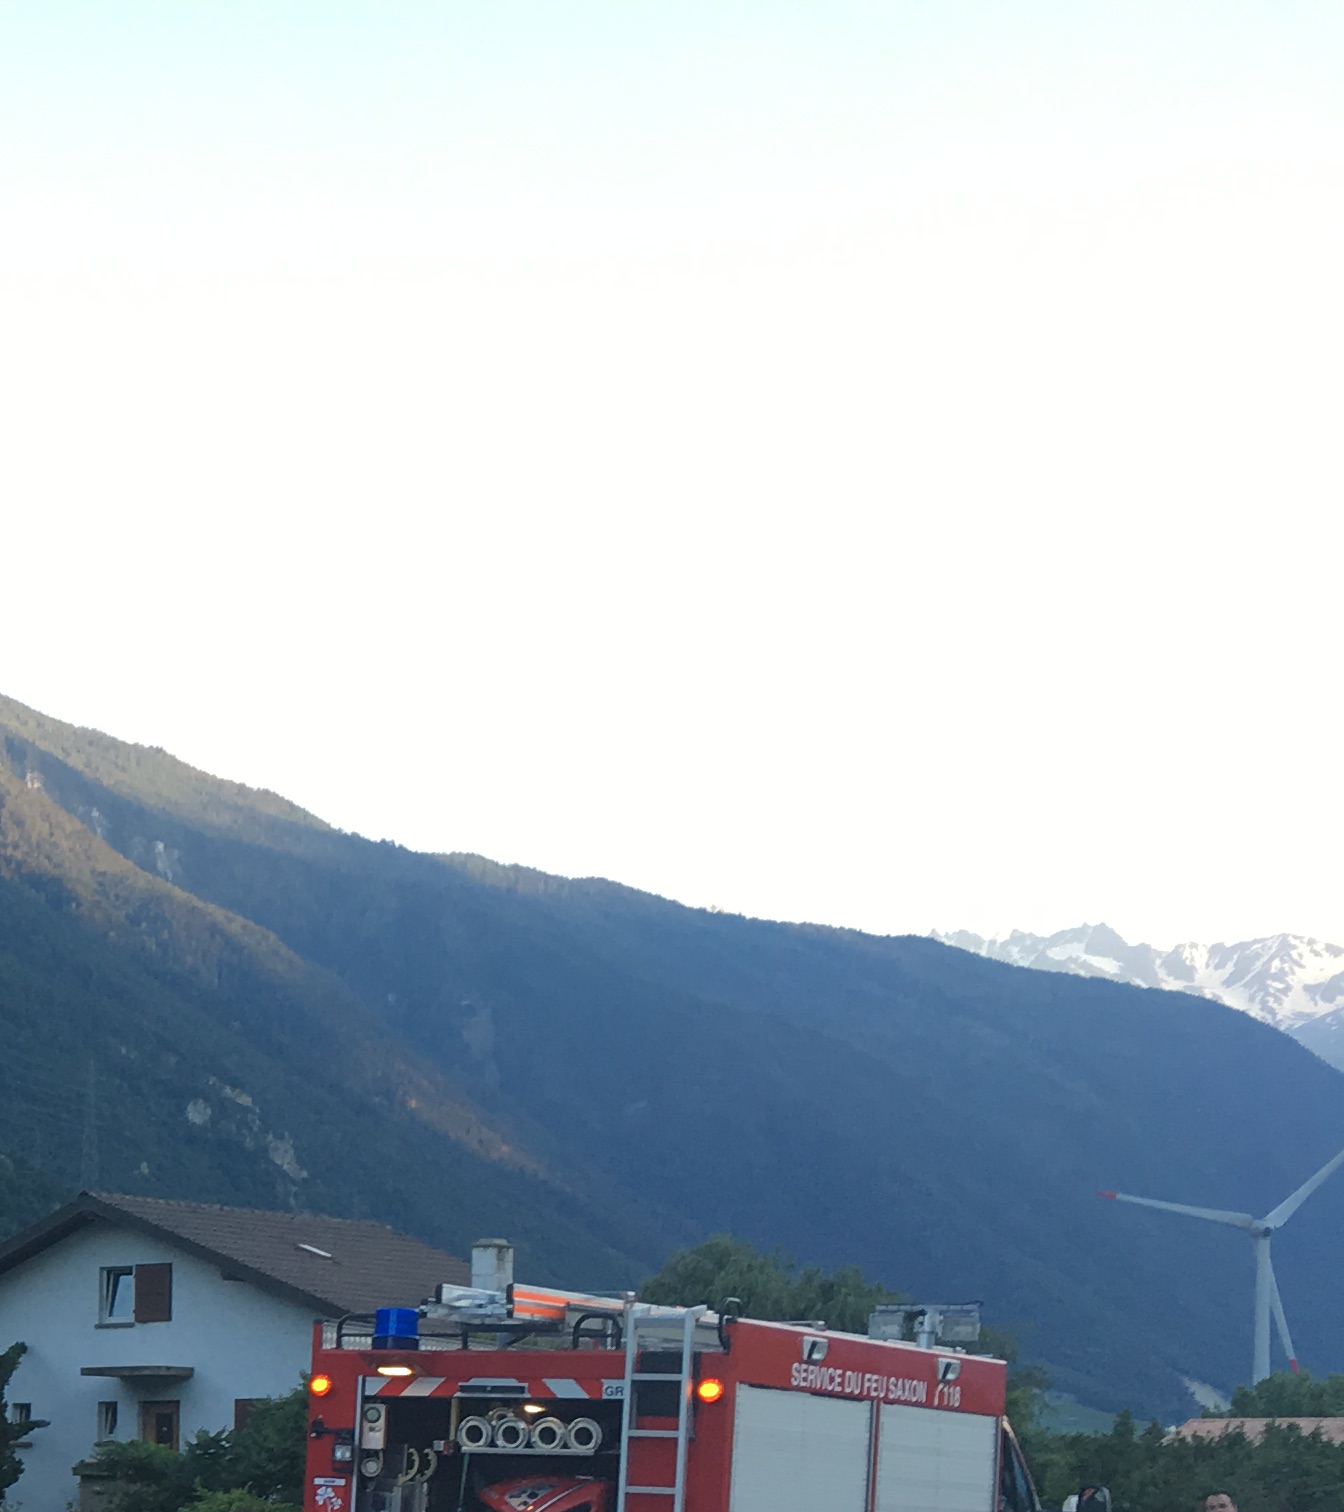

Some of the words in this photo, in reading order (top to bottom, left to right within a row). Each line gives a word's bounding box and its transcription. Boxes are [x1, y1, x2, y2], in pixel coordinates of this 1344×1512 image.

[791, 1362, 843, 1392] SERVICE
[843, 1370, 863, 1395] DU
[863, 1373, 887, 1399] FEU
[887, 1376, 928, 1403] SAXON
[942, 1384, 962, 1408] 118
